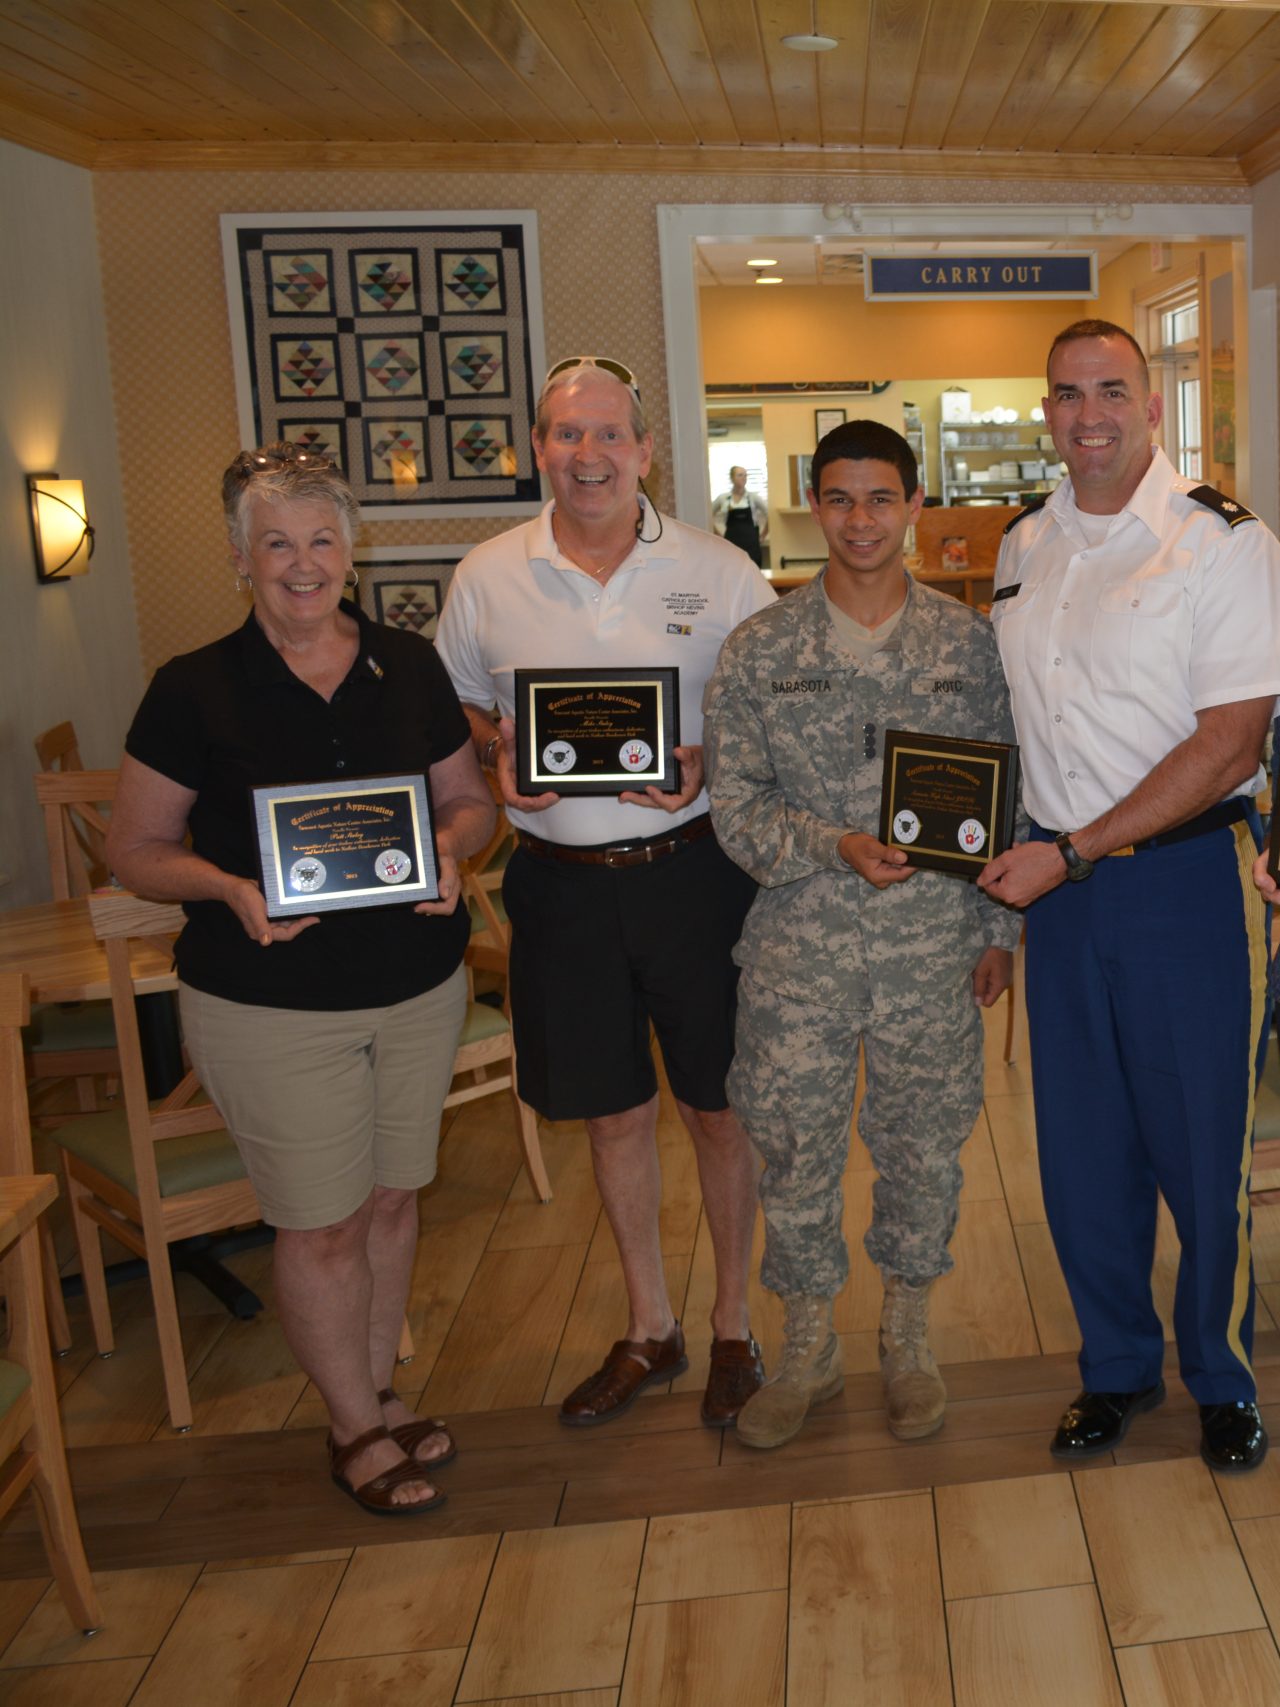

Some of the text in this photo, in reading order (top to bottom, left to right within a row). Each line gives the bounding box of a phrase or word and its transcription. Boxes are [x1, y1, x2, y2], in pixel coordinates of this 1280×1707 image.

[921, 266, 1042, 284] CARRY OUT
[771, 680, 831, 694] SARASOTA
[932, 680, 963, 693] JROTC
[548, 694, 583, 710] Certificate
[598, 692, 642, 708] Appreciation
[291, 802, 395, 826] Certificate of Appreciation
